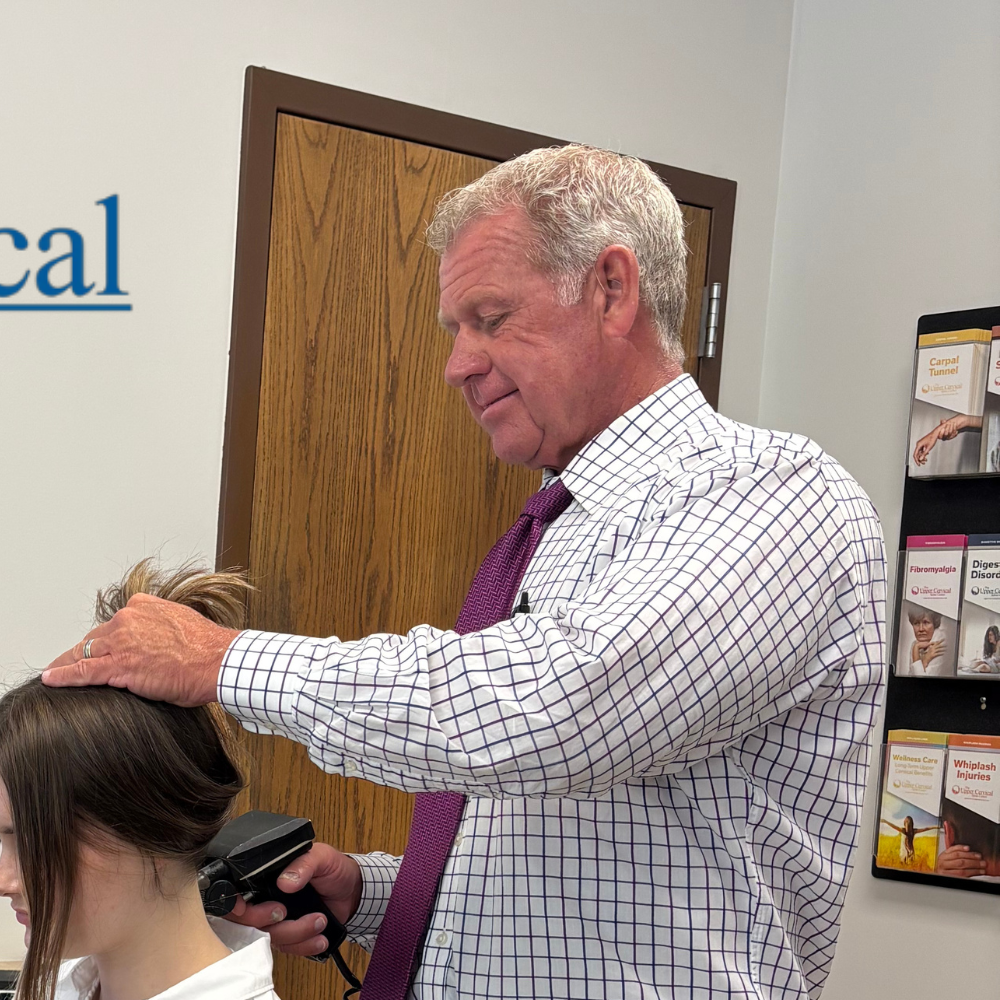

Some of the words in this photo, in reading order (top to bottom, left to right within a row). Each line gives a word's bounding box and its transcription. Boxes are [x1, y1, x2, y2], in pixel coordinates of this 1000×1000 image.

[929, 356, 959, 367] Carpal
[928, 366, 959, 376] Tunnel
[910, 566, 957, 574] Fibromyalgia
[972, 560, 1000, 570] Diges
[893, 754, 921, 763] Wellness
[953, 760, 997, 771] Whiplash
[957, 770, 991, 781] Injuries
